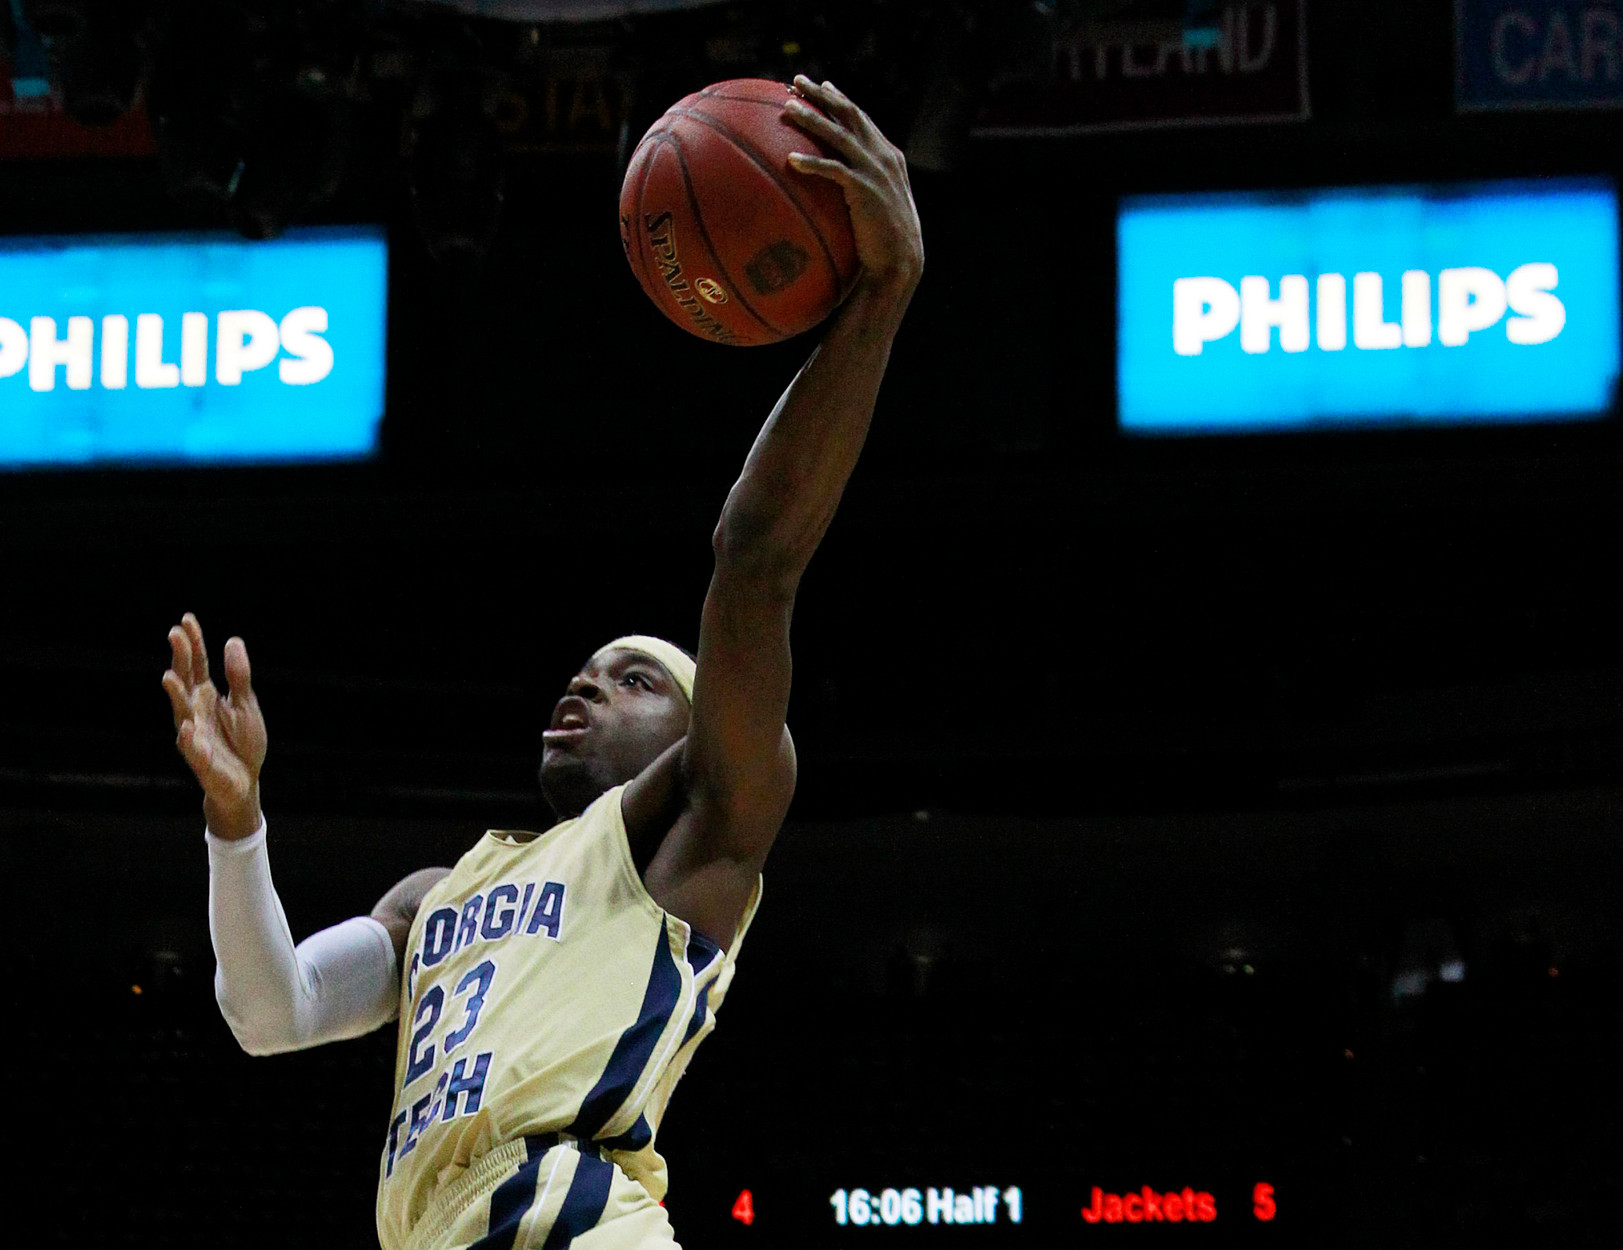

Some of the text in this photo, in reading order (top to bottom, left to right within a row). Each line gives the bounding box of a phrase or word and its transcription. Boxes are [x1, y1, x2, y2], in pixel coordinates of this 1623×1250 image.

[1173, 262, 1566, 356] PHILIPS
[403, 958, 497, 1090] 23
[731, 1188, 755, 1226] 4
[830, 1185, 1022, 1226] 16:06 Half 1
[1081, 1181, 1277, 1223] Jackets 5
